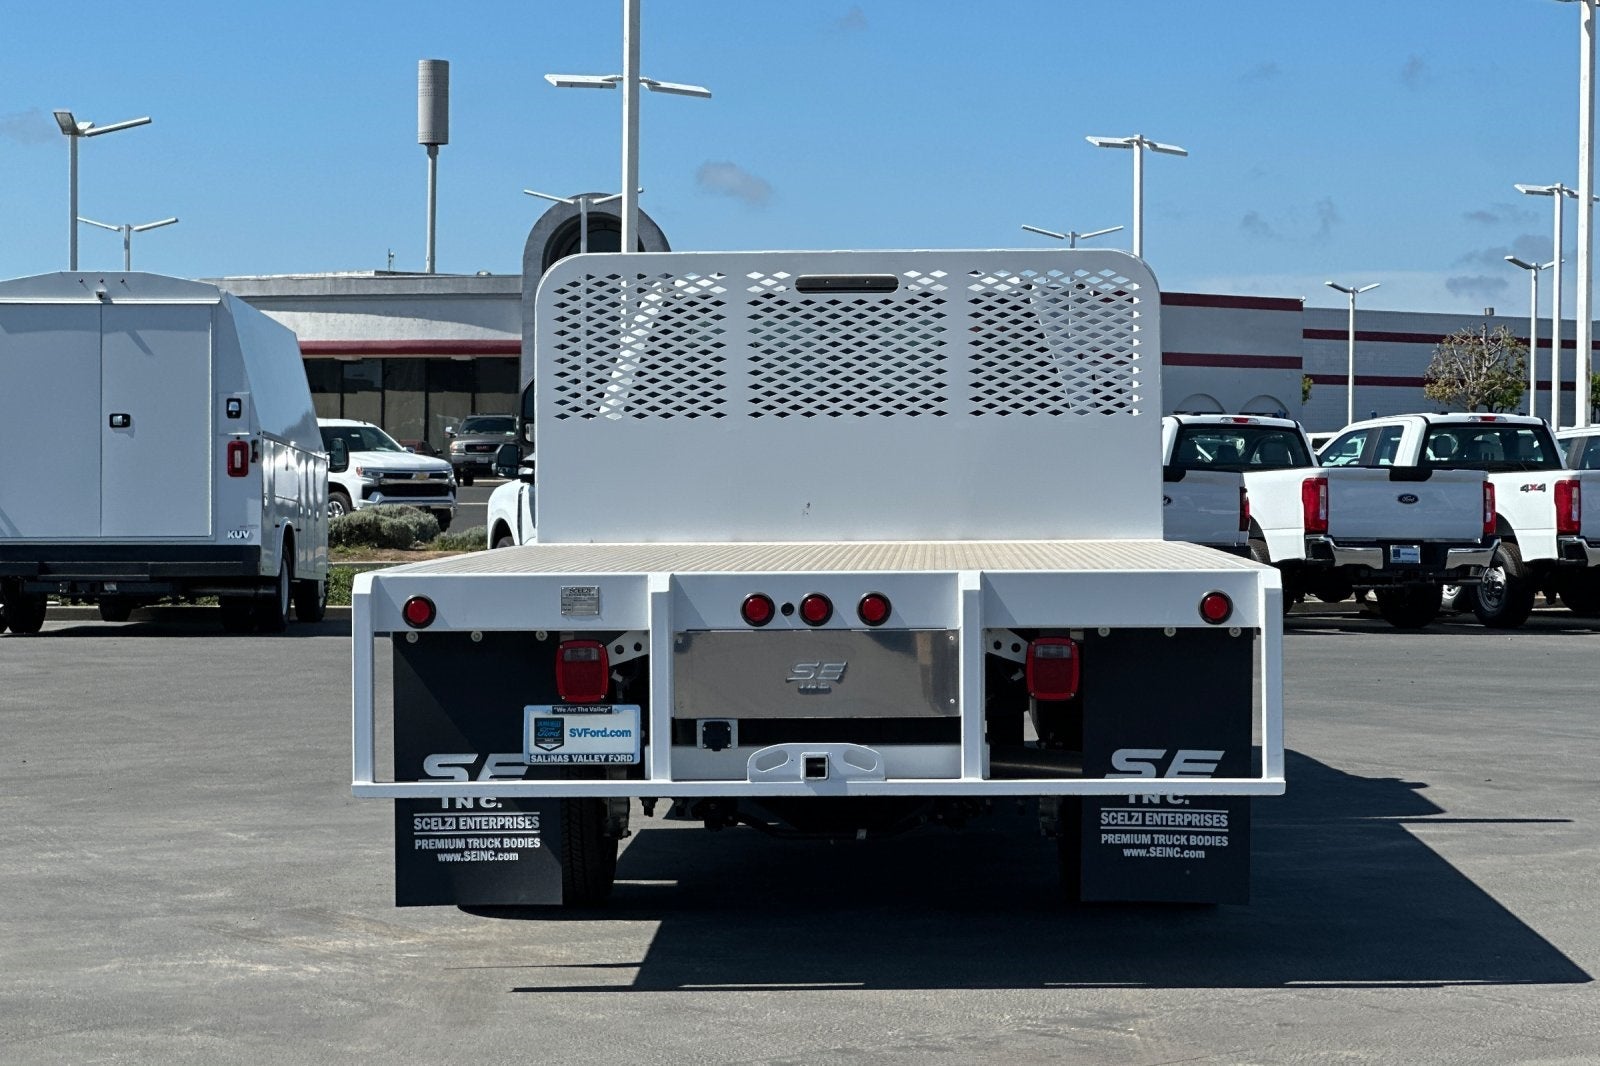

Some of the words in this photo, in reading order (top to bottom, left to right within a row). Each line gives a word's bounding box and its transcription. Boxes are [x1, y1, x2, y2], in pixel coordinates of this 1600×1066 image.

[227, 530, 250, 539] KUV
[786, 660, 847, 681] SE
[537, 727, 560, 737] Ford
[569, 727, 632, 738] SVFord.com
[530, 754, 569, 763] SALINAS
[571, 754, 607, 763] VALLEY
[608, 754, 633, 763] FORD
[1104, 748, 1226, 779] SE
[417, 753, 528, 781] SE
[413, 818, 456, 831] SCELZI
[459, 816, 540, 830] ENTERPRISES
[1100, 812, 1142, 825] SCELZI
[1145, 813, 1229, 827] ENTERPRISES
[414, 839, 466, 850] PREMIUM
[467, 838, 502, 849] TRUCK
[503, 837, 541, 849] BODIES
[1101, 833, 1151, 845] PREMIUM
[1152, 834, 1188, 846] TRUCK
[1189, 835, 1229, 847] BODIES
[437, 850, 519, 862] www.SEINC.com
[1122, 846, 1205, 859] www.SEINC.com
